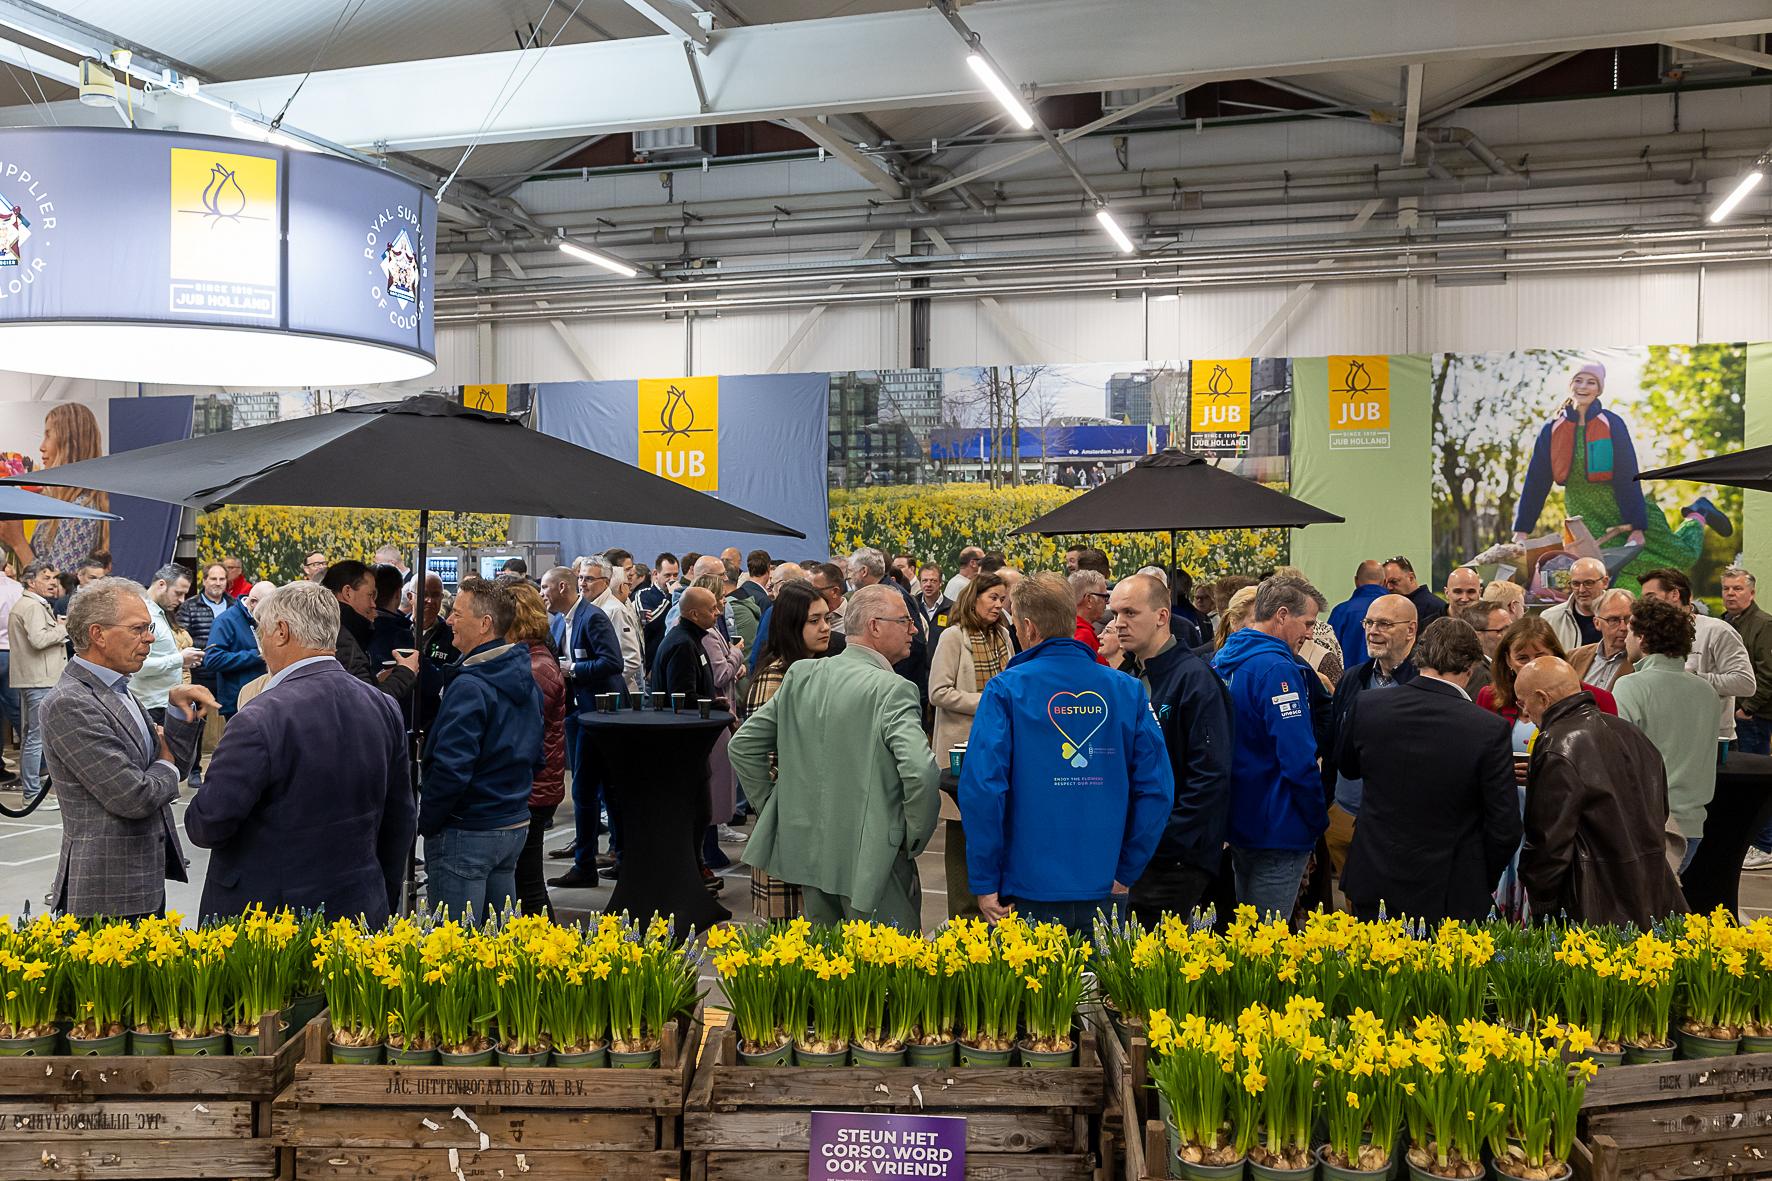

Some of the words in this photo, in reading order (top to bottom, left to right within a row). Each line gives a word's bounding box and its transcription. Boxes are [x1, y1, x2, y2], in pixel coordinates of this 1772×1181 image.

[364, 208, 394, 260] ROYAL
[176, 293, 205, 305] JUB
[207, 295, 270, 310] HOLLAND
[371, 286, 387, 309] OF
[1199, 405, 1241, 426] JUB
[1337, 402, 1380, 425] JUB
[1211, 439, 1247, 447] HOLLAND
[1332, 438, 1349, 446] JUB
[1350, 437, 1388, 445] HOLLAND
[1054, 706, 1102, 714] BESTUUR
[385, 1078, 412, 1095] JAC.
[525, 1079, 534, 1095] &
[540, 1079, 559, 1096] ZN.
[837, 1128, 897, 1144] STEUN
[902, 1131, 938, 1146] HET
[821, 1143, 890, 1159] CORSO.
[893, 1147, 953, 1162] WORD
[826, 1158, 867, 1174] OOK
[872, 1161, 947, 1177] VRIEND!
